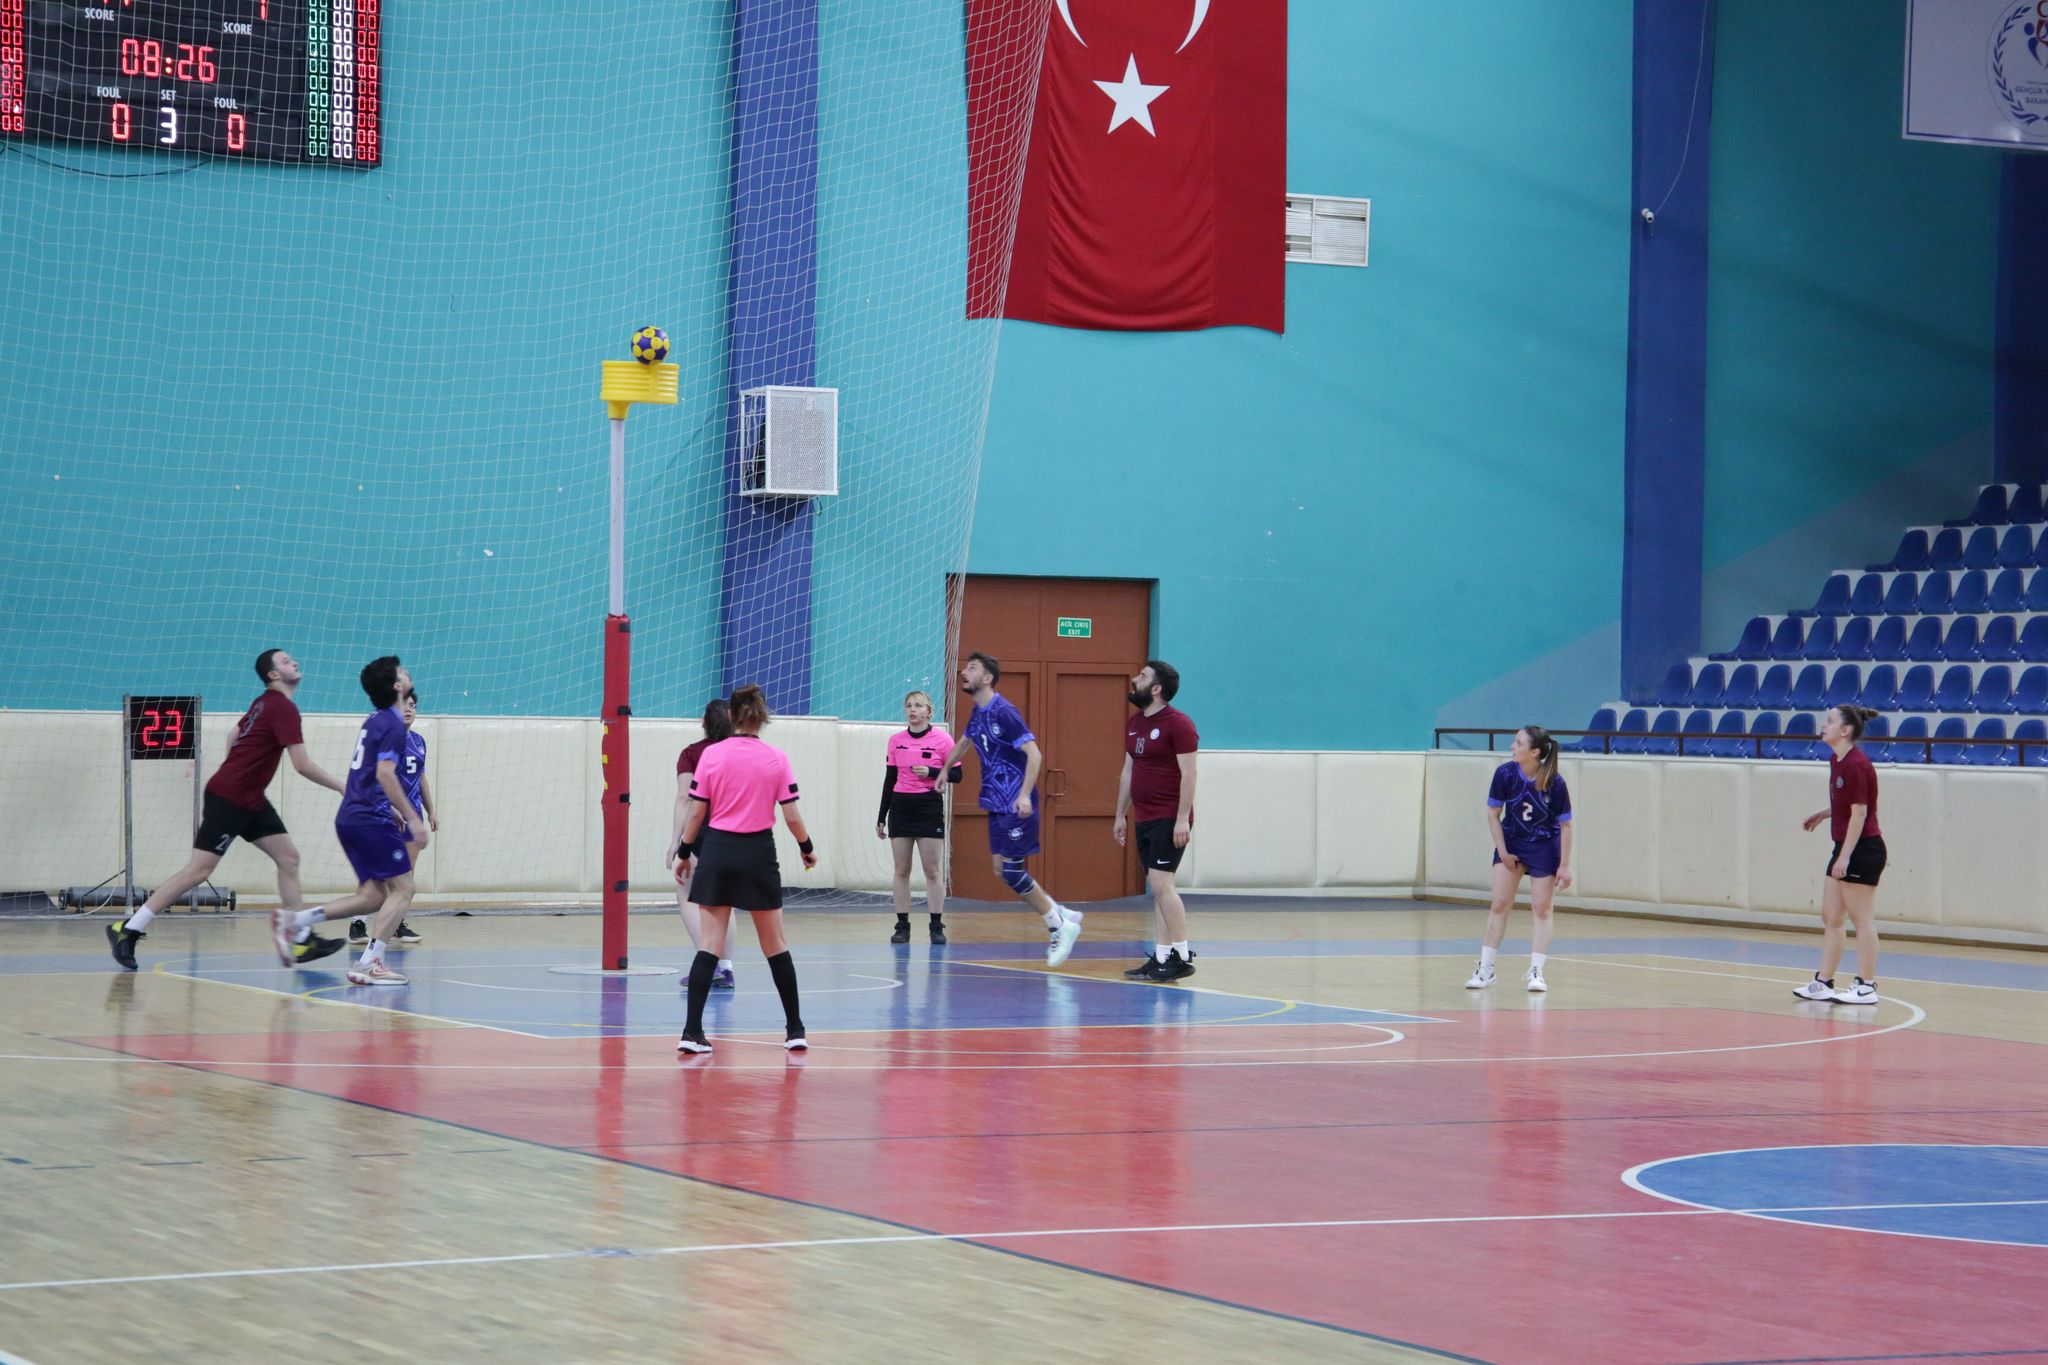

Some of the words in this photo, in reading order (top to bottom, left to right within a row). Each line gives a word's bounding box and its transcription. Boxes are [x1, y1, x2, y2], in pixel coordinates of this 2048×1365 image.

[84, 7, 114, 21] SCORE
[223, 22, 252, 35] SCORE
[122, 38, 216, 83] 08:26
[97, 86, 121, 100] FOUL
[161, 89, 176, 101] SET
[214, 97, 238, 110] FOUL
[112, 104, 129, 140] 0
[160, 106, 177, 144] 3
[228, 114, 244, 150] 0
[142, 710, 182, 746] 23
[1136, 737, 1145, 754] 18
[406, 756, 416, 774] 5
[1522, 802, 1533, 821] 2
